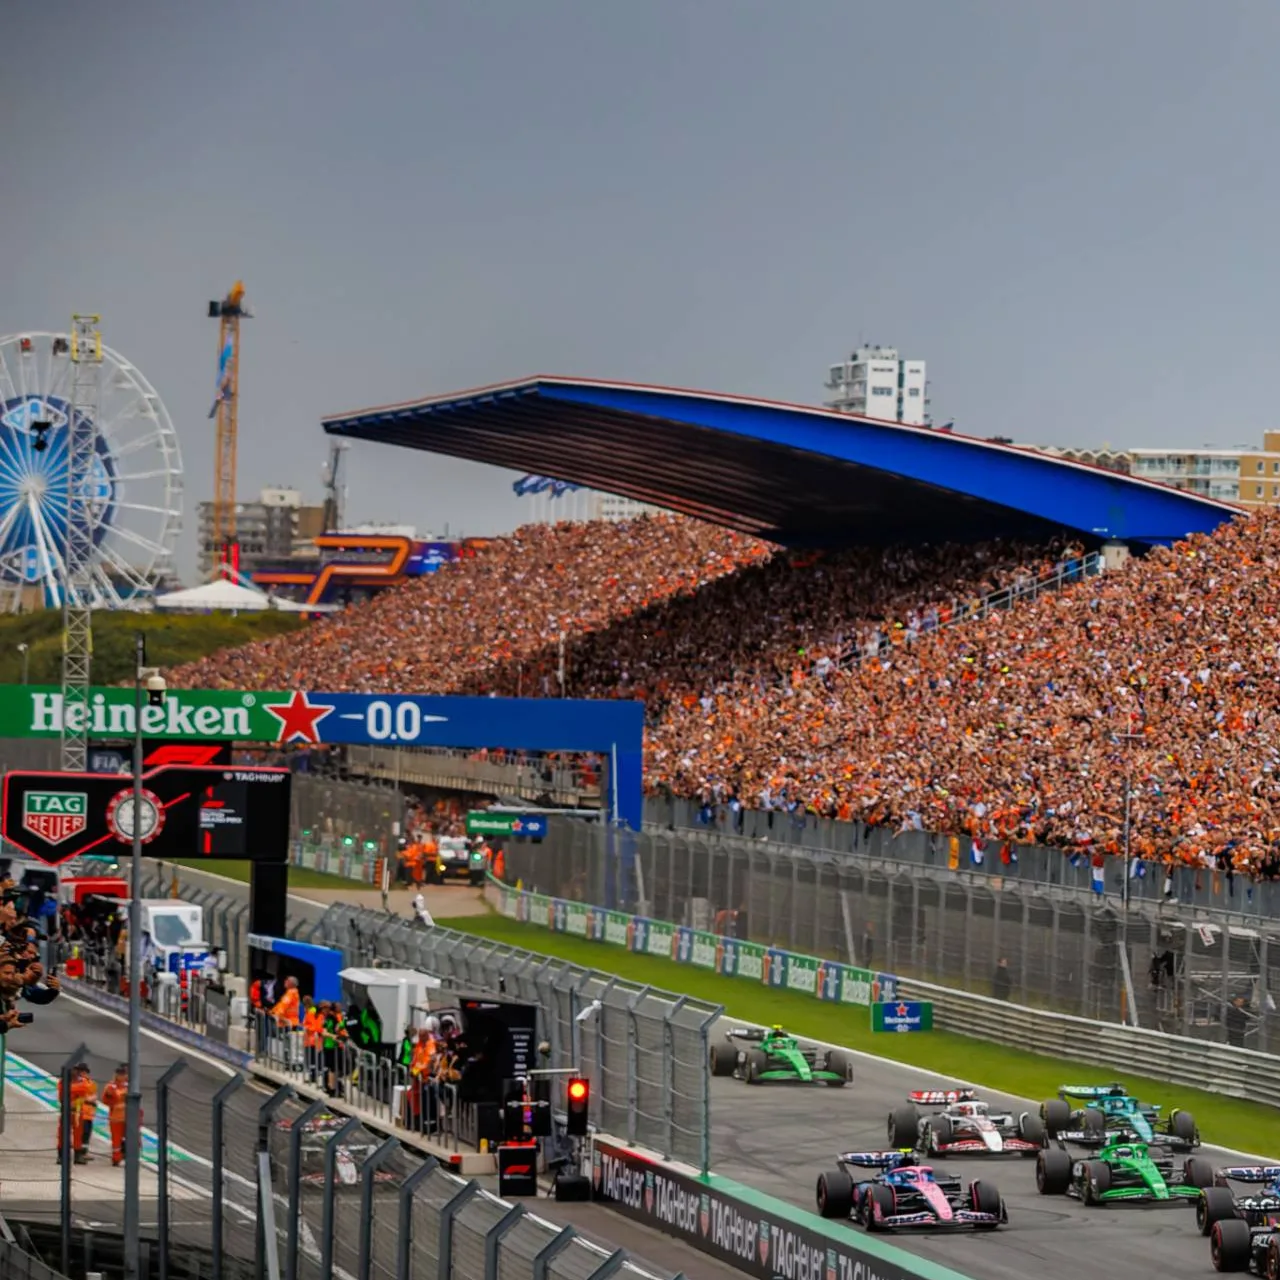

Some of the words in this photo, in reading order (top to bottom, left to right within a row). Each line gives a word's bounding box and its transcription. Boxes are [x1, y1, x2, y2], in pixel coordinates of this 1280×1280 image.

[366, 700, 421, 740] 0.0
[30, 796, 81, 812] TAG
[26, 815, 84, 842] HEUER
